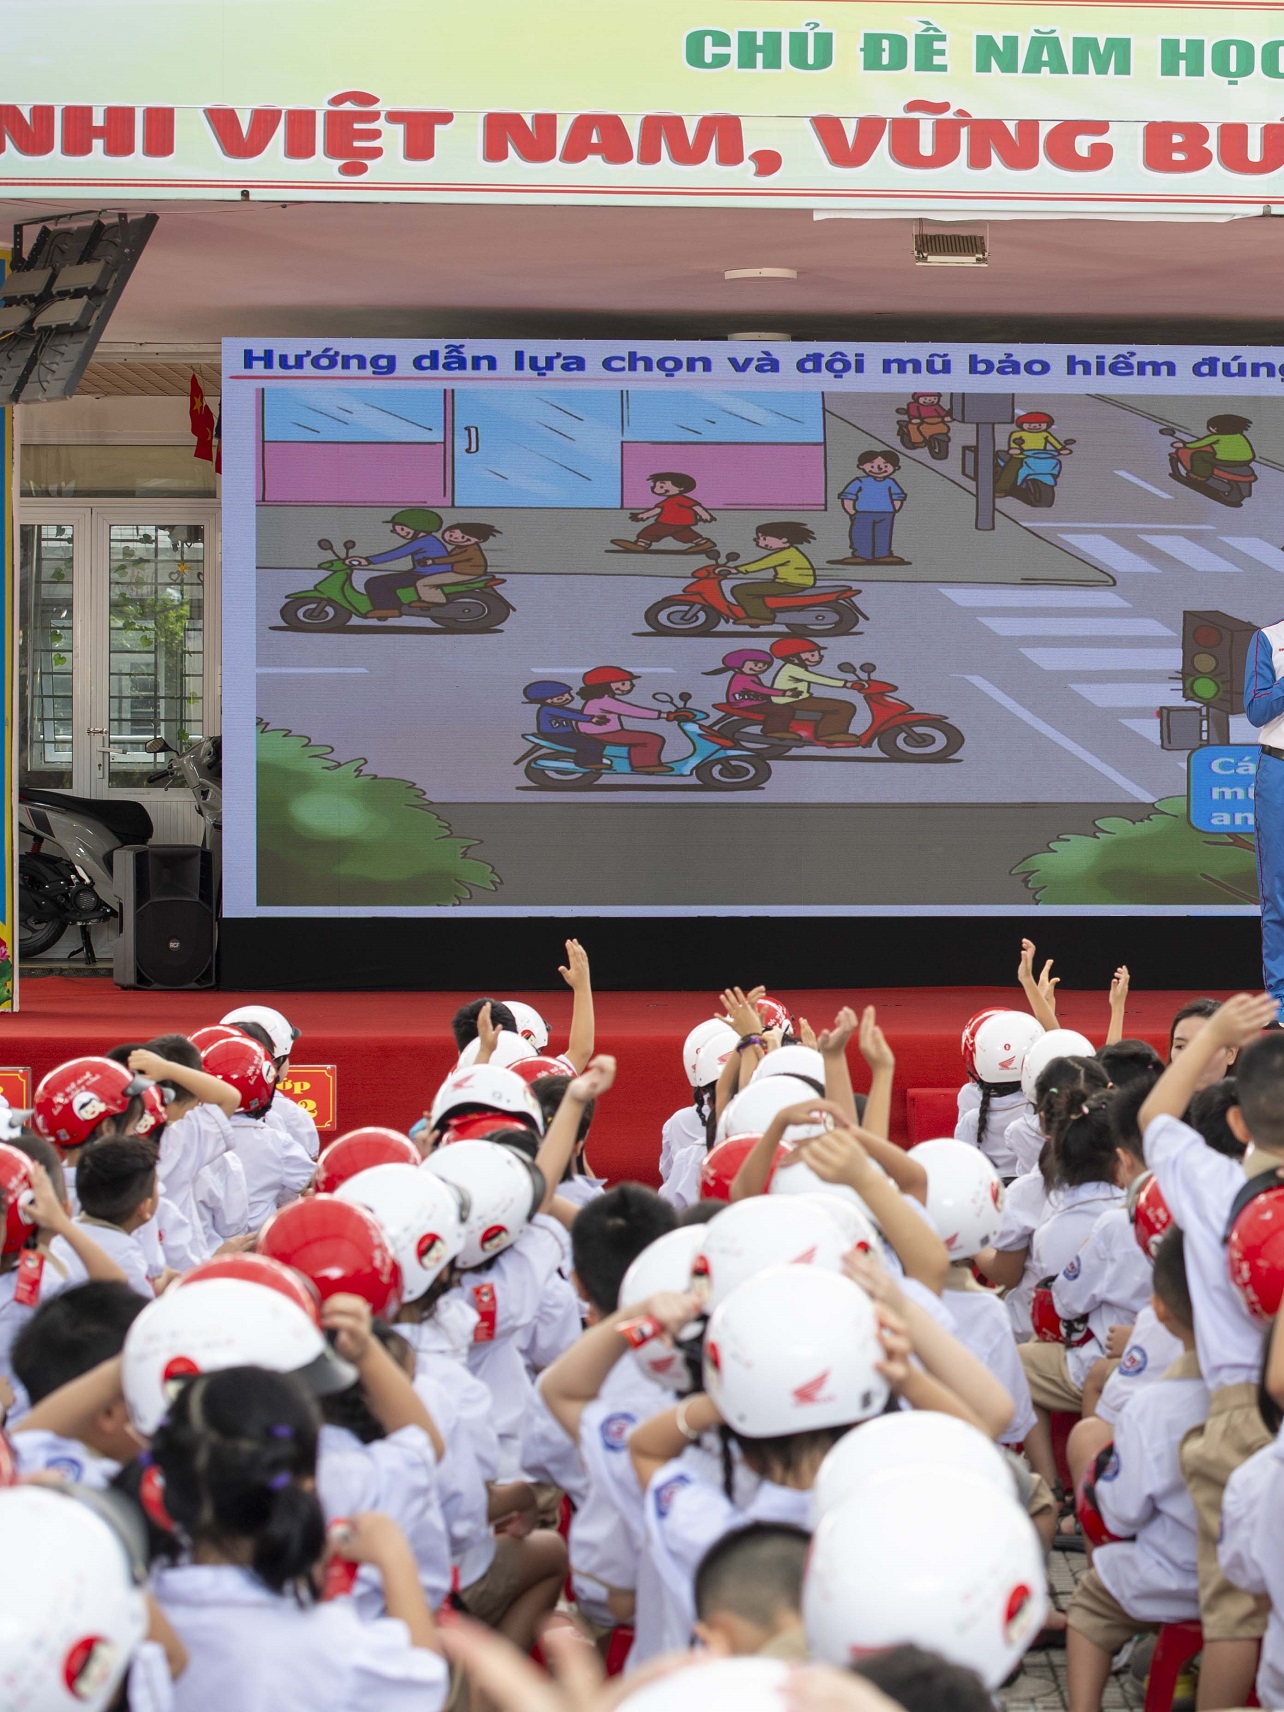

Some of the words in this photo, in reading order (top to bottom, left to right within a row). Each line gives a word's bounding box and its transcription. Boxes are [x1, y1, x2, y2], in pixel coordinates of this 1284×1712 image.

[685, 21, 834, 71] CHỦ
[860, 20, 949, 73] ĐỀ
[975, 28, 1132, 76] NĂM
[0, 104, 175, 159] NHI
[204, 90, 454, 177] VIỆT
[483, 112, 783, 178] NAM,
[810, 99, 1115, 172] VỮNG
[243, 347, 397, 375] Hướng
[412, 343, 497, 371] dẫn
[515, 349, 586, 376] lựa
[601, 350, 713, 377] chọn
[728, 350, 782, 373] và
[796, 351, 865, 379] đội
[882, 352, 952, 375] mũ
[968, 352, 1050, 376] bảo
[1067, 351, 1177, 377] hiểm
[1211, 756, 1257, 774] Cá
[276, 1077, 311, 1094] ớp
